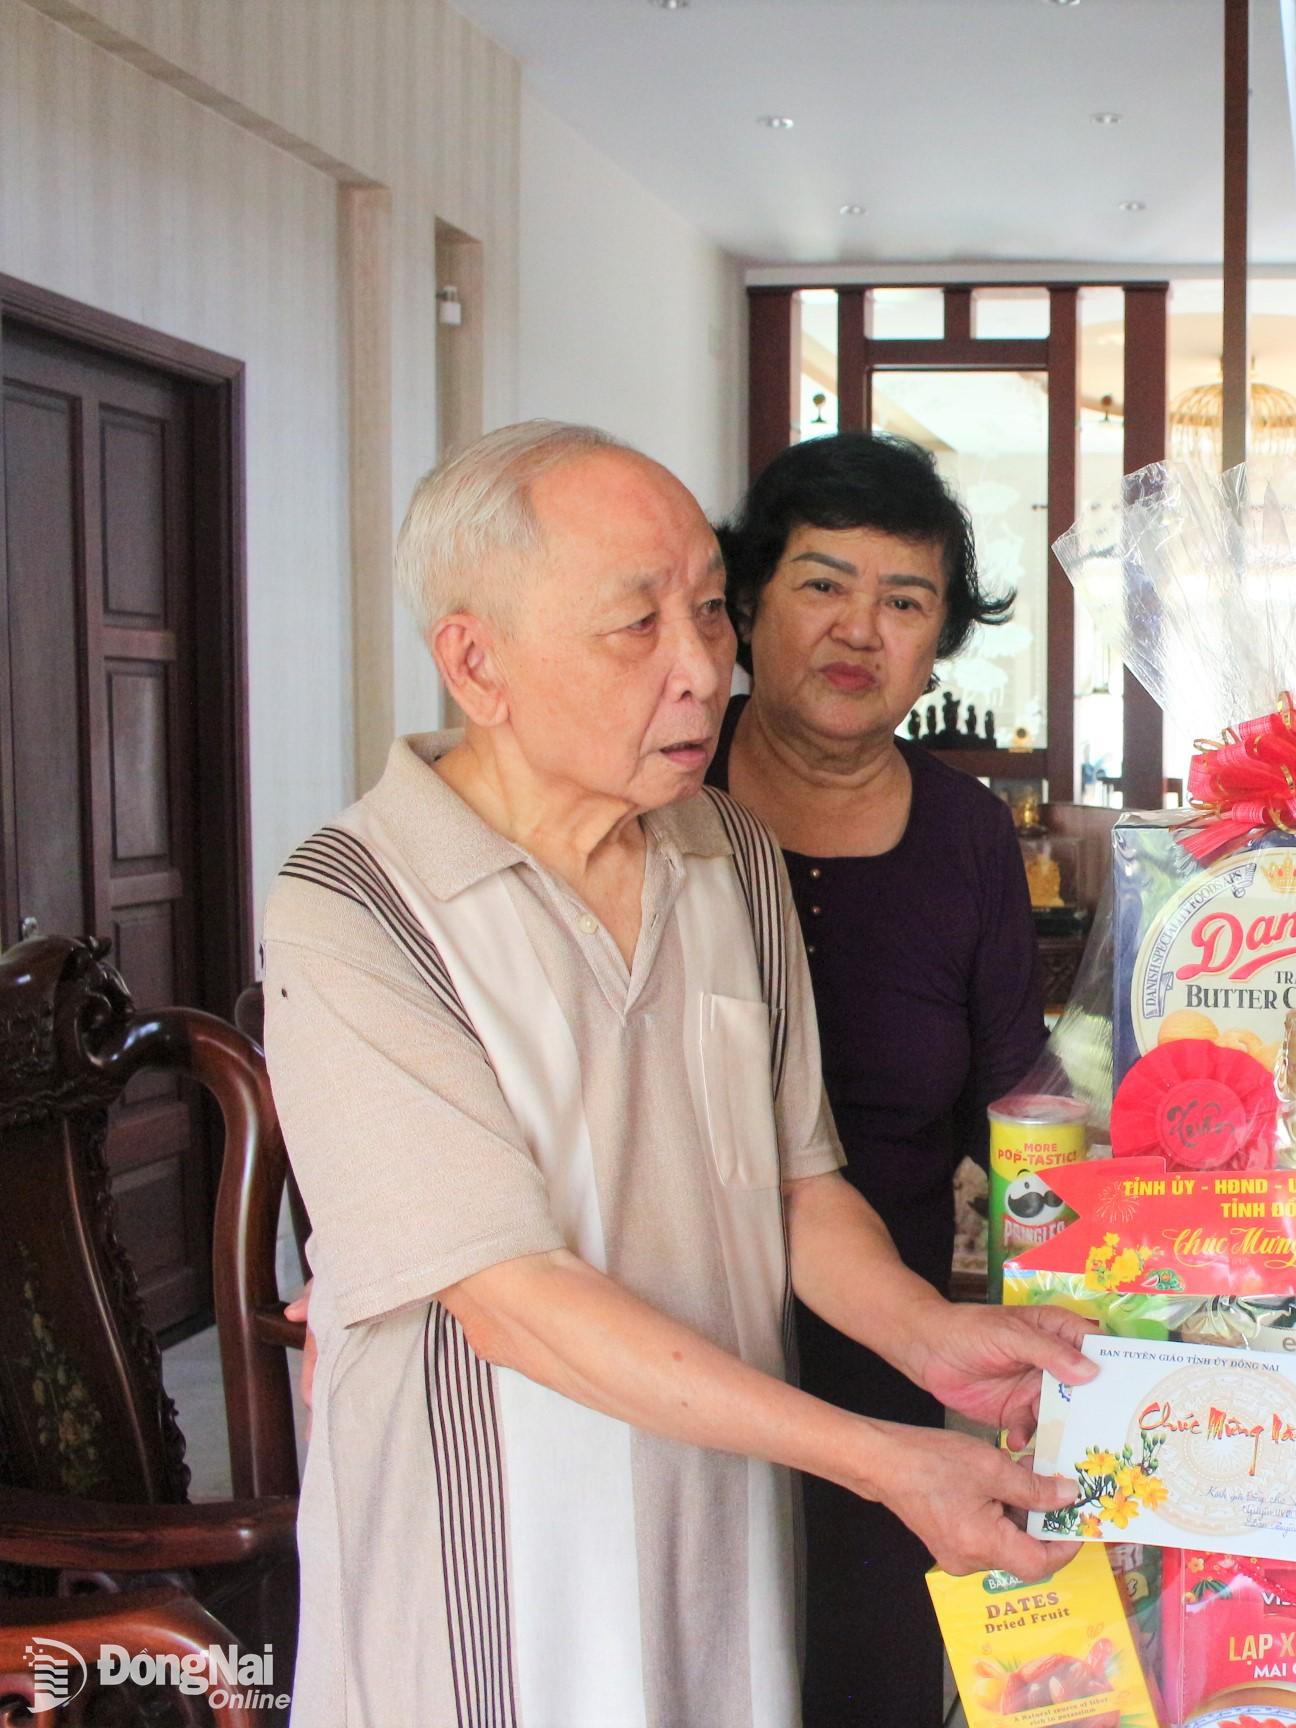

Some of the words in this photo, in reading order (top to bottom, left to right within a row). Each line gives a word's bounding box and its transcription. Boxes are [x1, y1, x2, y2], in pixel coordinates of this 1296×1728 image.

[1145, 963, 1161, 1007] DANISH
[1186, 984, 1277, 1009] BUTTER
[997, 1148, 1077, 1166] POP-TASTIC!
[1024, 1143, 1057, 1153] MORE
[1123, 1176, 1166, 1196] TỈNH
[1171, 1175, 1196, 1195] ỦY
[1215, 1178, 1268, 1195] HĐND
[1099, 1348, 1120, 1358] BAN
[1123, 1350, 1157, 1361] TUYÊN
[1158, 1353, 1184, 1363] GIÁO
[1186, 1353, 1211, 1366] TỈNH
[1261, 1363, 1280, 1372] NAI
[1138, 1401, 1203, 1435] Chúc
[985, 1591, 1060, 1620] DATES
[984, 1617, 1026, 1634] Dried
[1031, 1607, 1071, 1625] Fruit
[1229, 1632, 1273, 1666] LẠP
[1253, 1661, 1287, 1678] MAI
